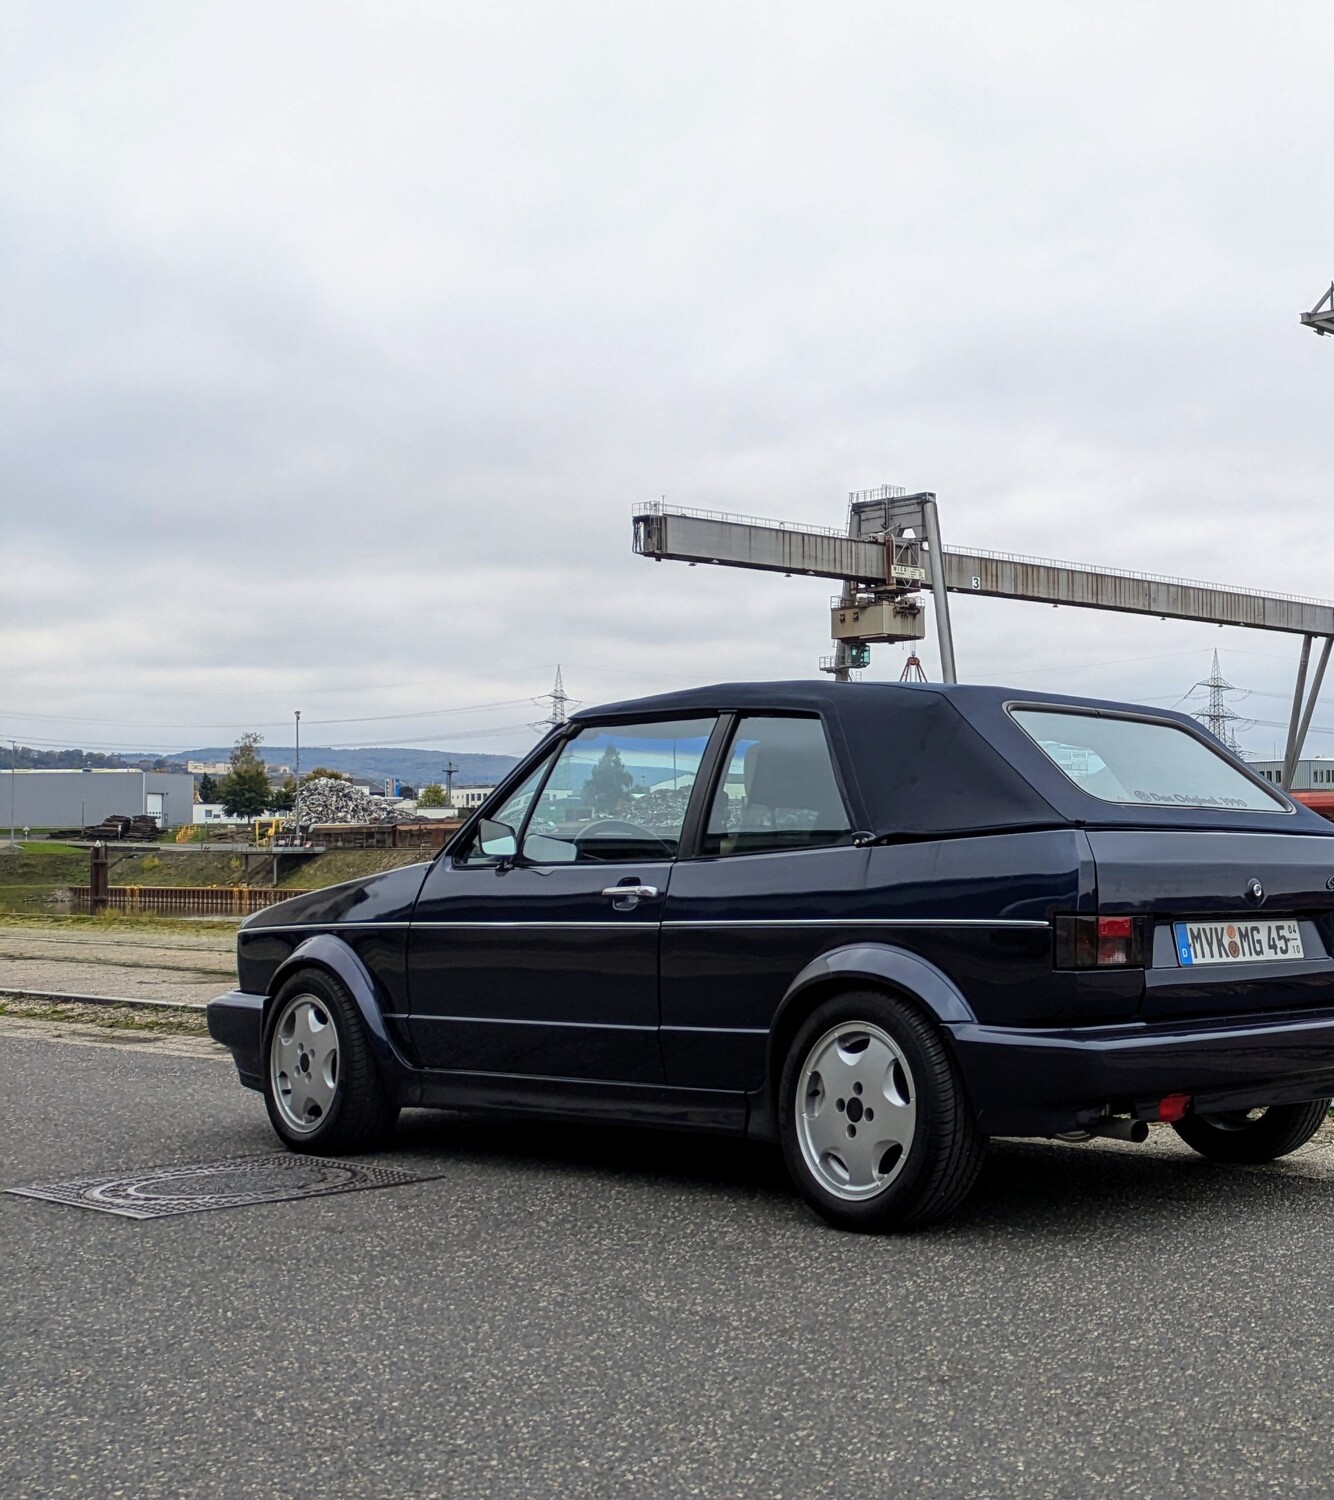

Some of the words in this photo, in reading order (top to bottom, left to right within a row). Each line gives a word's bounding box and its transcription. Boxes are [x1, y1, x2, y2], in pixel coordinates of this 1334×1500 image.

[973, 577, 979, 588] 3
[1149, 792, 1175, 802] Das
[1181, 948, 1187, 958] D
[1189, 926, 1229, 959] MYK
[1238, 925, 1264, 957] MG
[1267, 924, 1289, 955] 45
